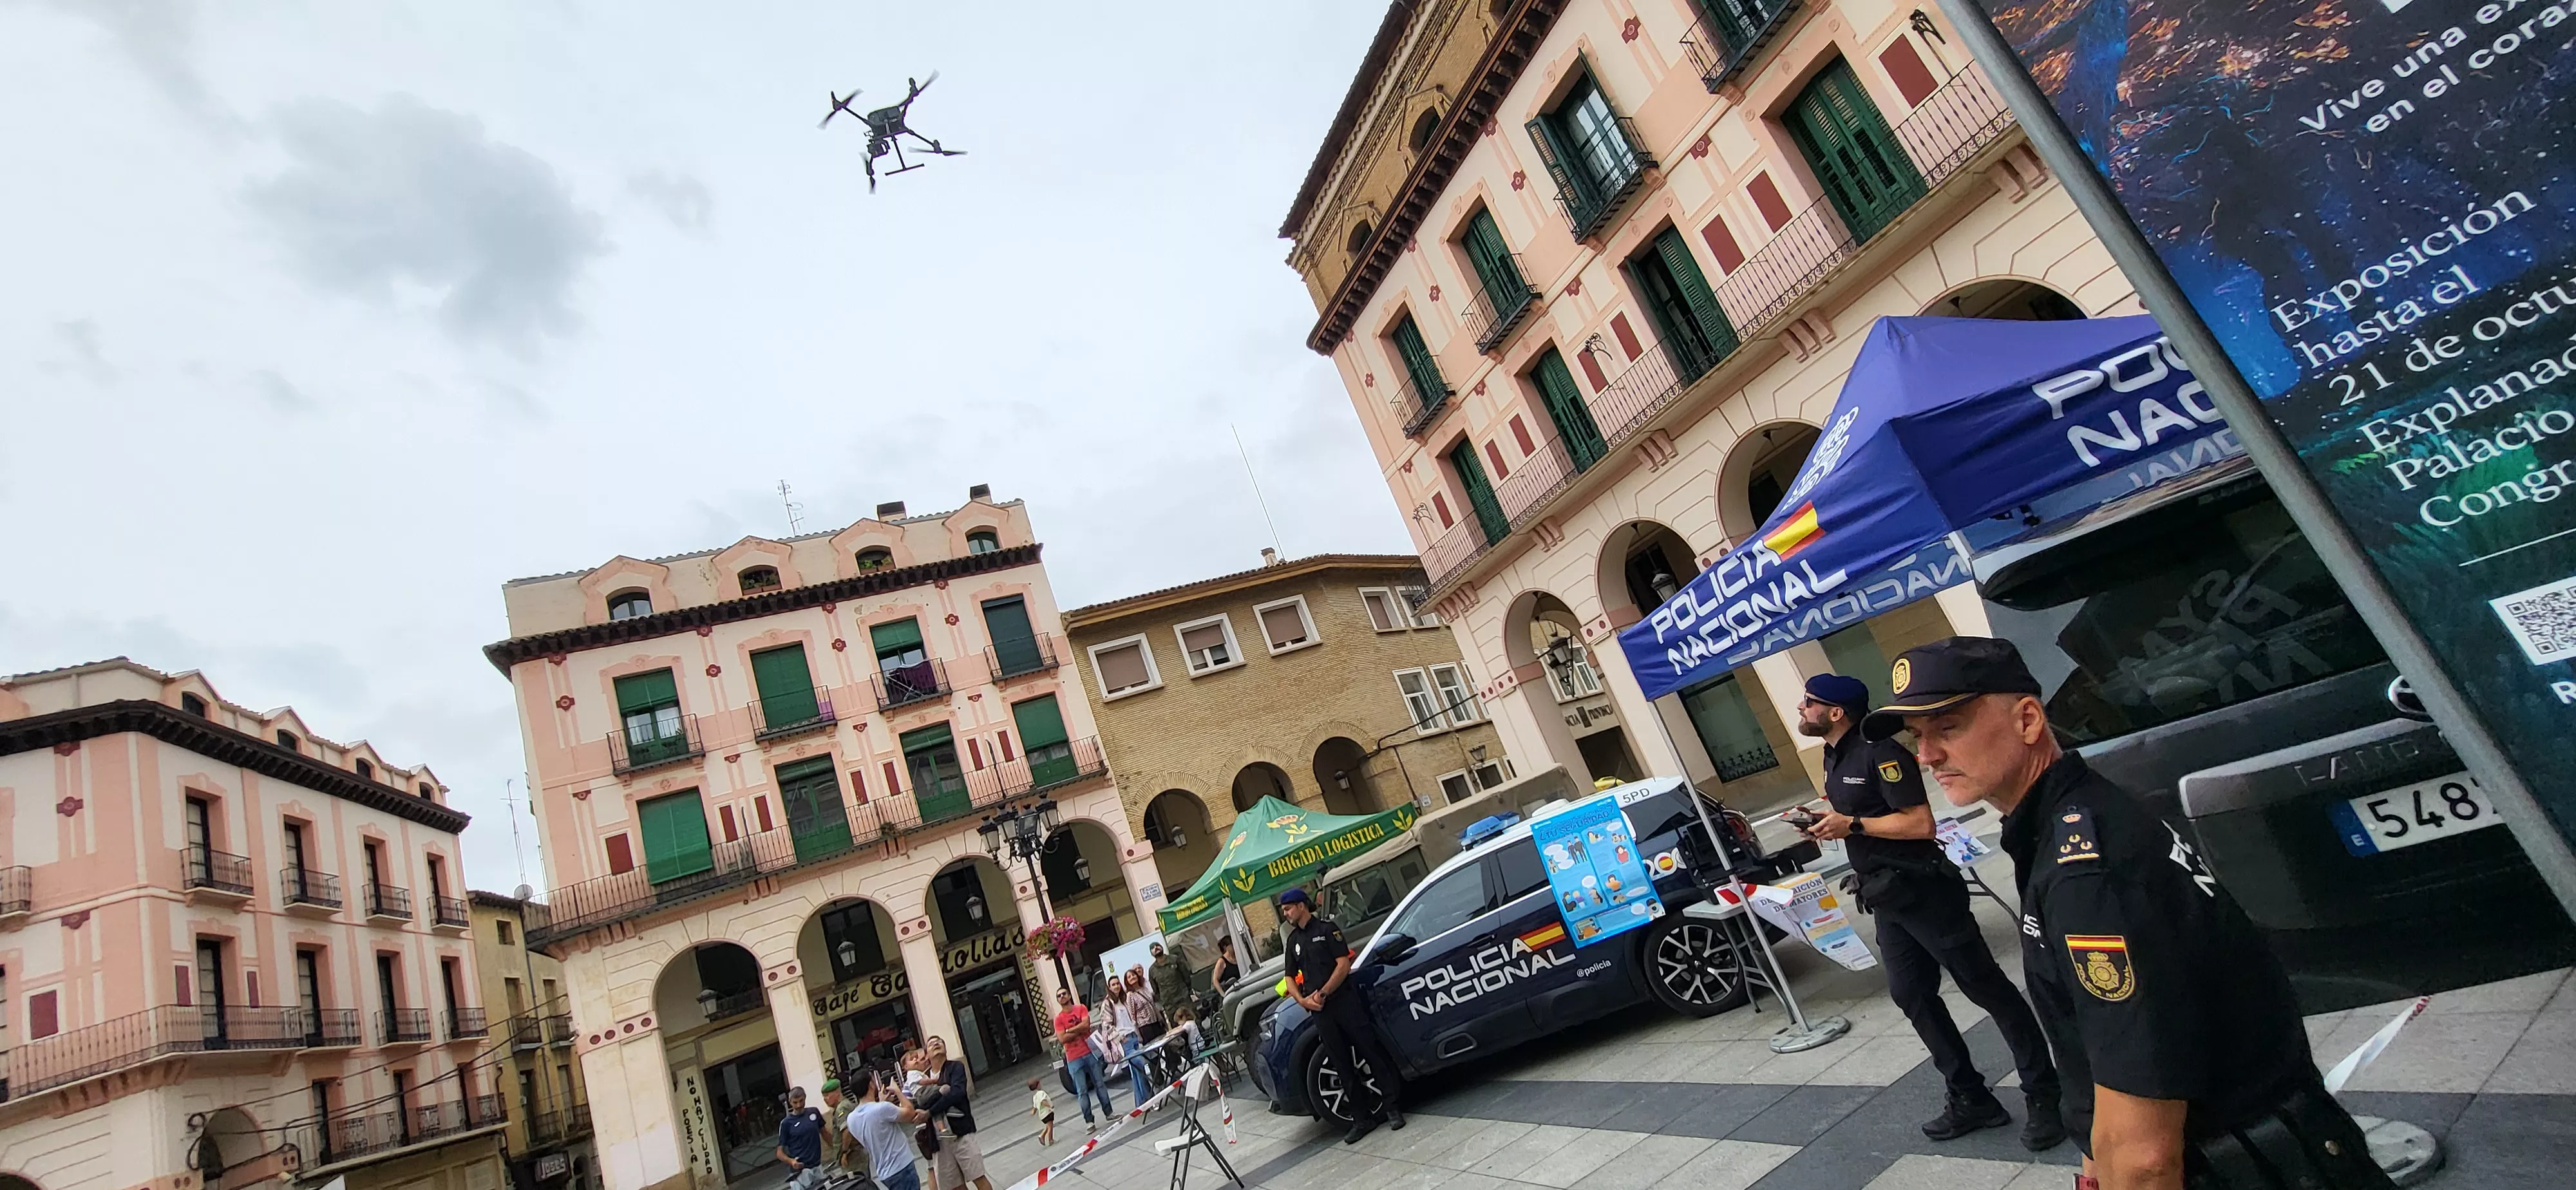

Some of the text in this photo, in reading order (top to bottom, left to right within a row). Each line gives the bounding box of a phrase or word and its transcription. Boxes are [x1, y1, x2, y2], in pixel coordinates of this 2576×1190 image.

[2298, 79, 2385, 130] Vive
[2392, 26, 2468, 77] una
[2366, 0, 2576, 133] en el cora
[2269, 190, 2537, 333] Exposición
[2292, 263, 2480, 369] hasta el
[2329, 362, 2394, 407] 21
[2405, 334, 2465, 372] de
[2384, 409, 2575, 491] Palacio
[2420, 459, 2576, 526] Congr
[1667, 560, 1849, 675] NACIONAL
[1623, 788, 1651, 804] 5PD
[2367, 777, 2499, 838] 548
[1267, 845, 1325, 878] BRIGADA
[1790, 888, 1828, 908] MAYORES
[813, 983, 859, 1015] Café
[1410, 949, 1577, 1020] NACIONAL
[1577, 959, 1612, 978] @policia
[687, 1076, 696, 1095] NO
[694, 1096, 705, 1125] HAY
